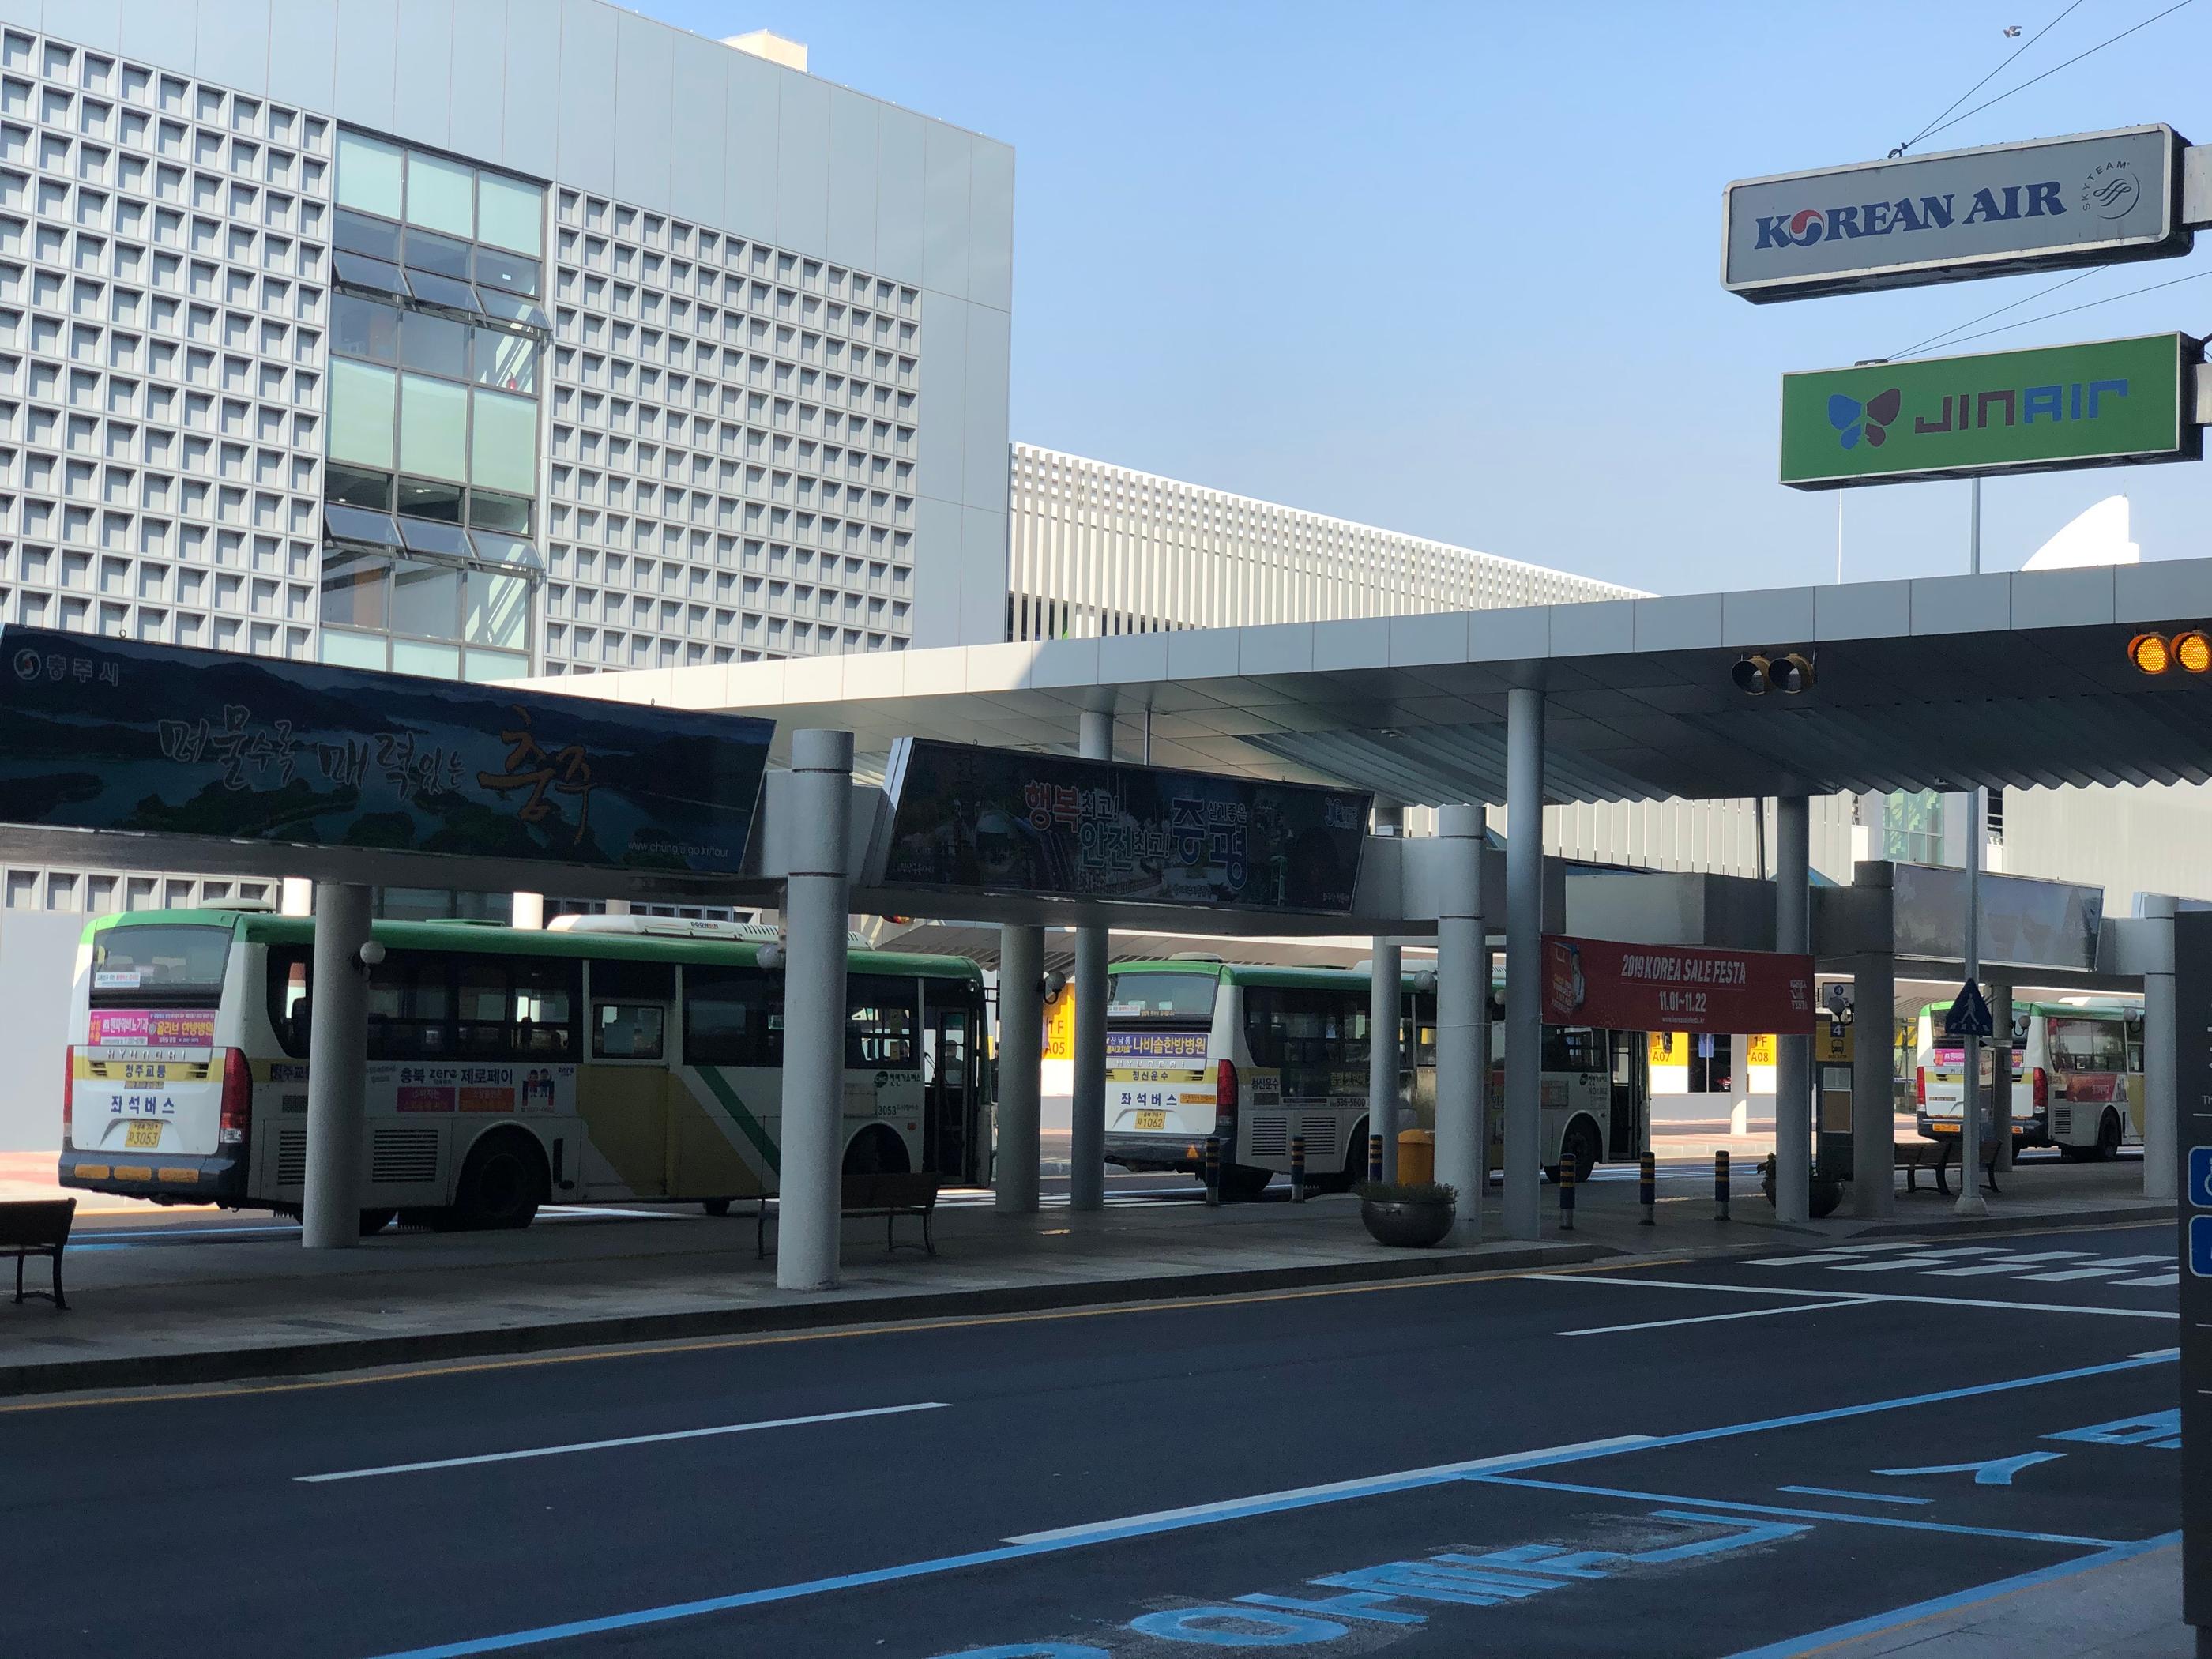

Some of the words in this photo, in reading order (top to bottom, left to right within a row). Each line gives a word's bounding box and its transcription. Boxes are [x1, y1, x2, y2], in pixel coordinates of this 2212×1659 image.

[2081, 160, 2127, 212] SKYTEAM
[1753, 194, 1955, 249] KOREAN
[1962, 180, 2067, 225] AIR
[46, 654, 119, 687] 충주시
[158, 704, 297, 791] 머물수록
[476, 704, 598, 845] 충주
[1025, 779, 1080, 833] 행복
[1080, 790, 1119, 820] 최고!
[1207, 801, 1247, 823] 살기좋은
[1079, 821, 1134, 871] 안전
[1134, 827, 1172, 859] 최고!
[1171, 796, 1248, 890] 증평
[1683, 958, 1712, 982] SALE
[1713, 960, 1746, 984] FESTA
[1659, 991, 1706, 1013] 11.01~11.22
[1833, 1025, 1842, 1036] 4
[107, 1048, 186, 1060] HYUNDAI
[1045, 1041, 1065, 1055] A05
[1134, 1036, 1206, 1055] 나비솔한방병원
[1653, 1051, 1671, 1063] A07
[1751, 1051, 1769, 1063] A08
[126, 1064, 166, 1078] 청주교통
[401, 1067, 425, 1084] 충북
[461, 1067, 514, 1085] 제로페이
[111, 1095, 175, 1115] 좌석버스
[878, 1105, 897, 1115] 3053
[1121, 1093, 1177, 1107] 좌석버스
